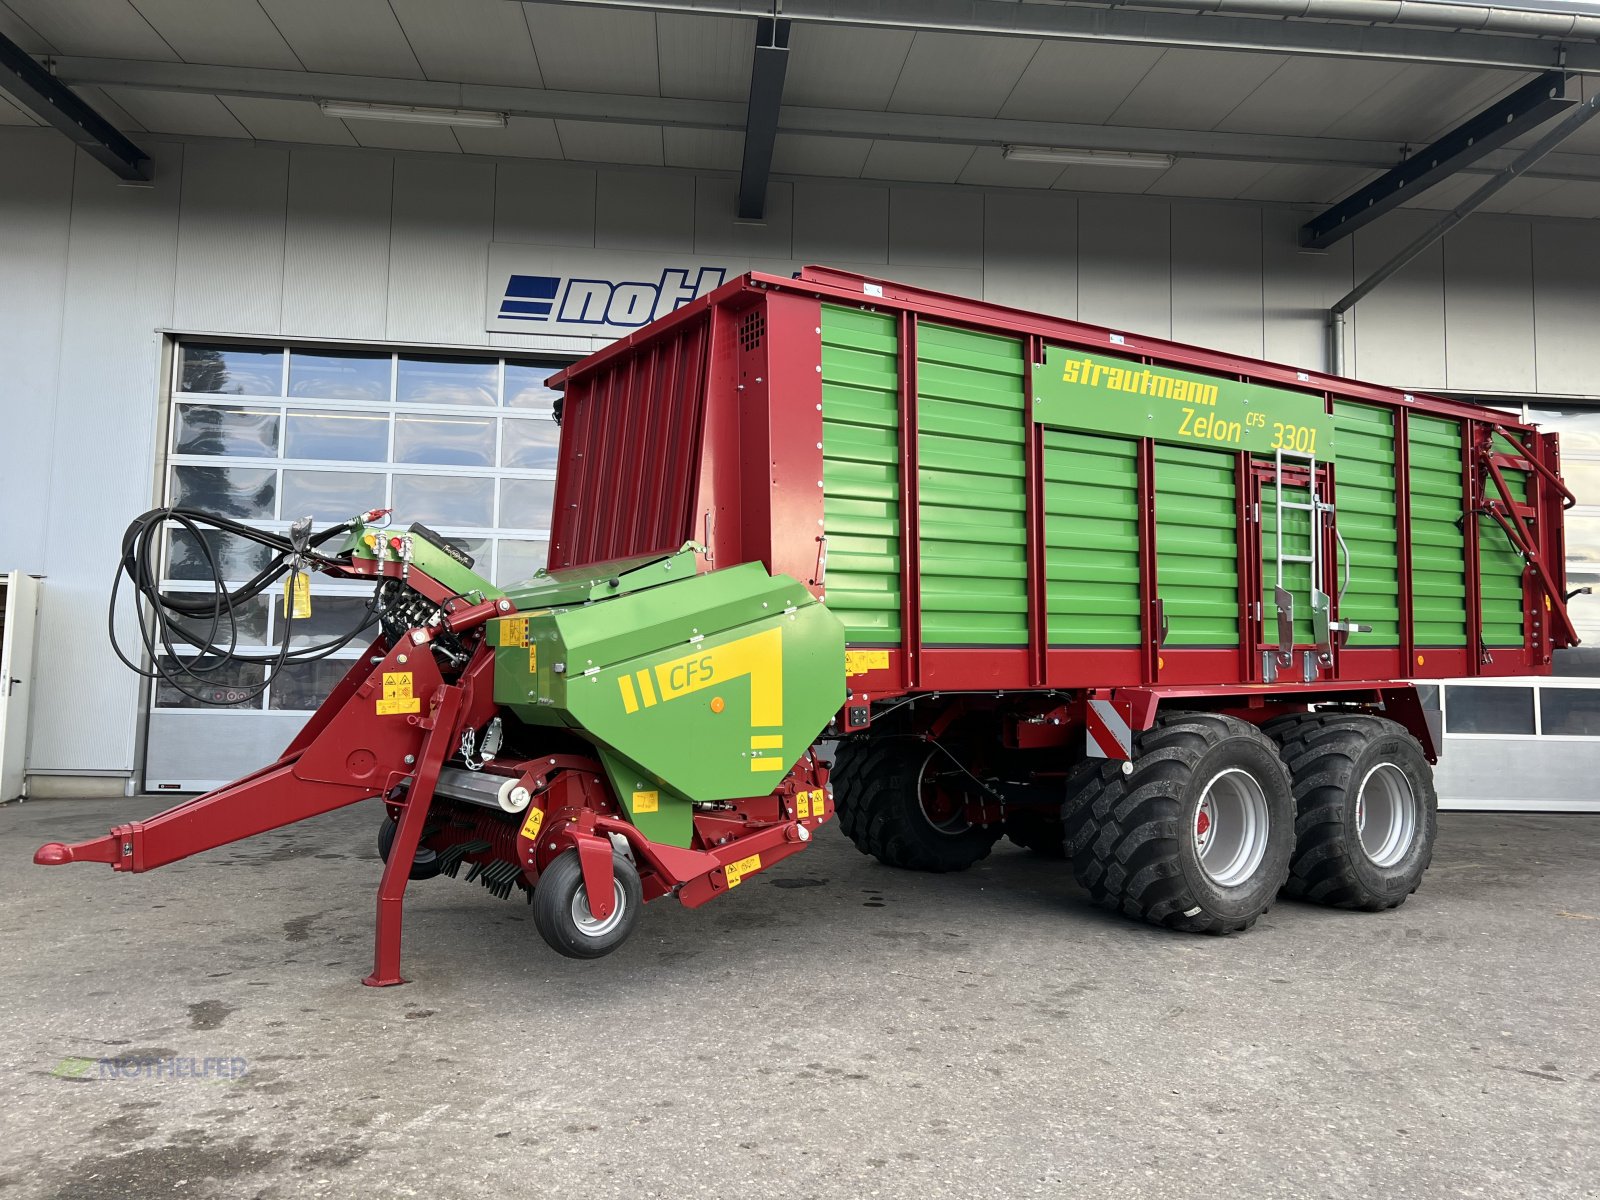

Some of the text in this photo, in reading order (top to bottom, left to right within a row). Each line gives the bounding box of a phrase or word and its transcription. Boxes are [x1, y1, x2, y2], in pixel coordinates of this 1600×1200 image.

[1063, 359, 1218, 406] strautmann
[1178, 407, 1317, 454] Zelon CFS 3301
[669, 655, 714, 691] CFS
